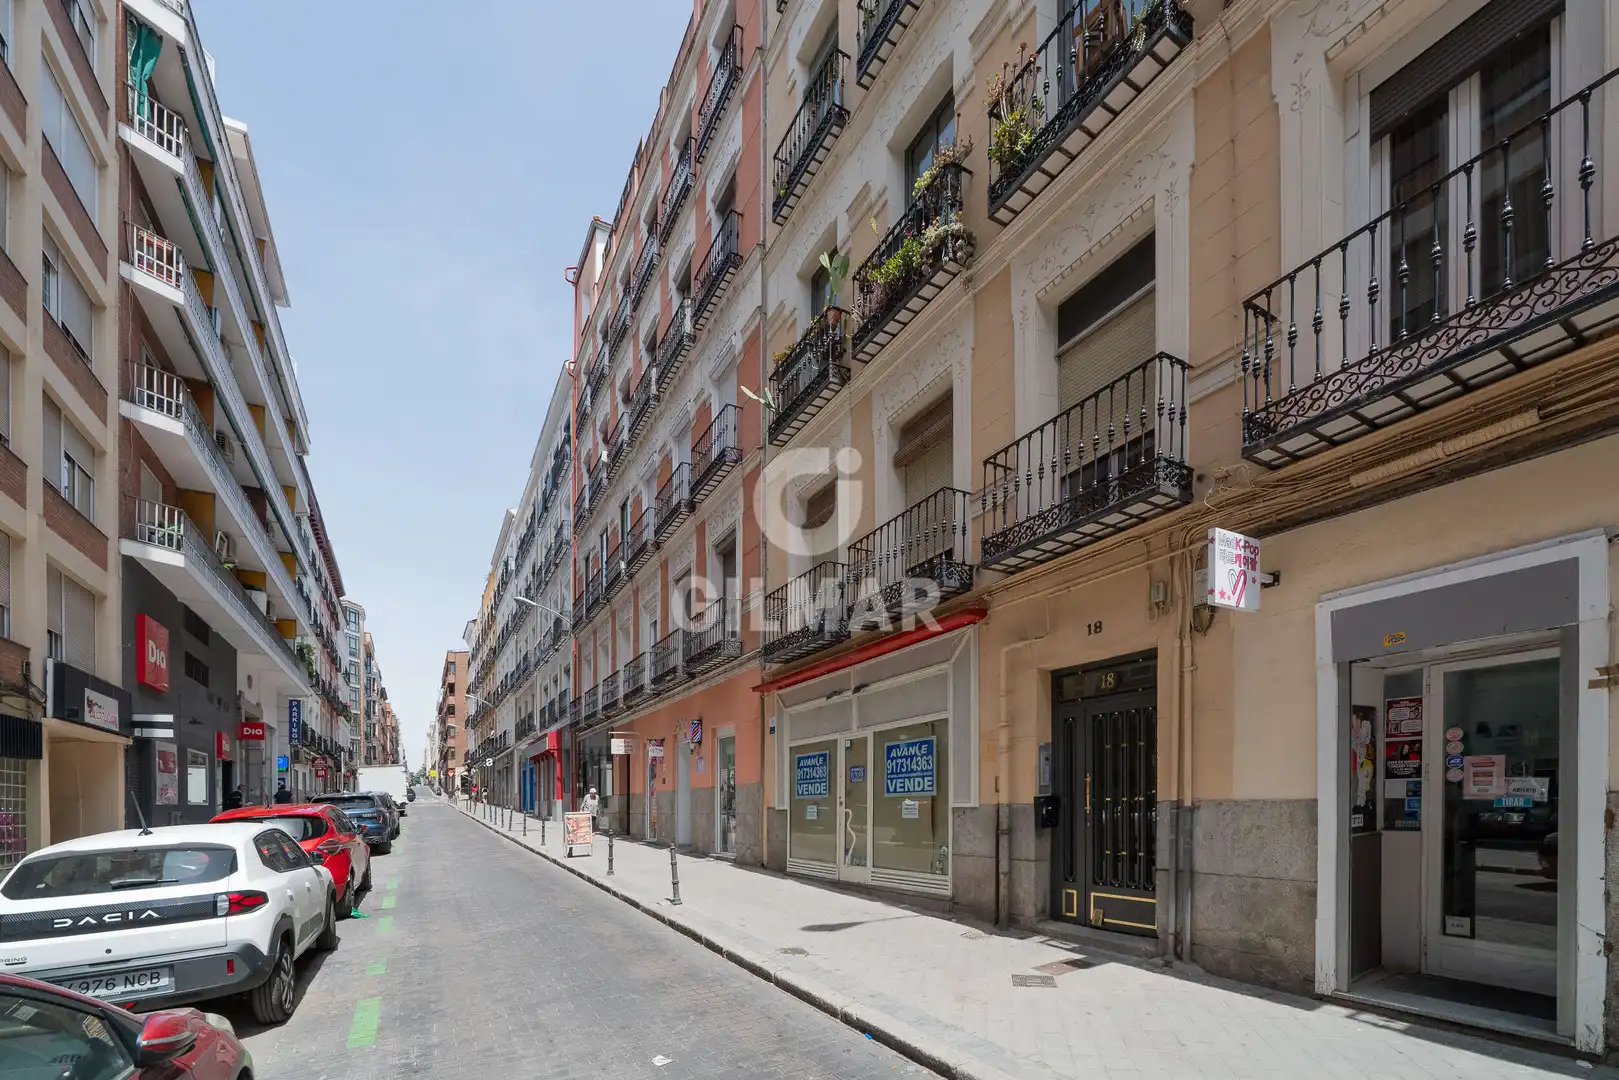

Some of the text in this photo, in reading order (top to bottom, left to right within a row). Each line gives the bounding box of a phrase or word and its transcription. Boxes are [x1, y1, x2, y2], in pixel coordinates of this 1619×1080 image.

[1087, 620, 1103, 637] 18
[148, 640, 167, 669] Dia
[1101, 672, 1114, 688] 18
[243, 727, 263, 735] Dia
[887, 755, 932, 773] 917314363
[797, 766, 827, 780] 917314363
[797, 783, 827, 795] VENDE
[887, 777, 932, 792] VENDE
[1502, 797, 1524, 807] TIRAR
[53, 910, 161, 928] DACIA
[124, 971, 161, 989] NCB
